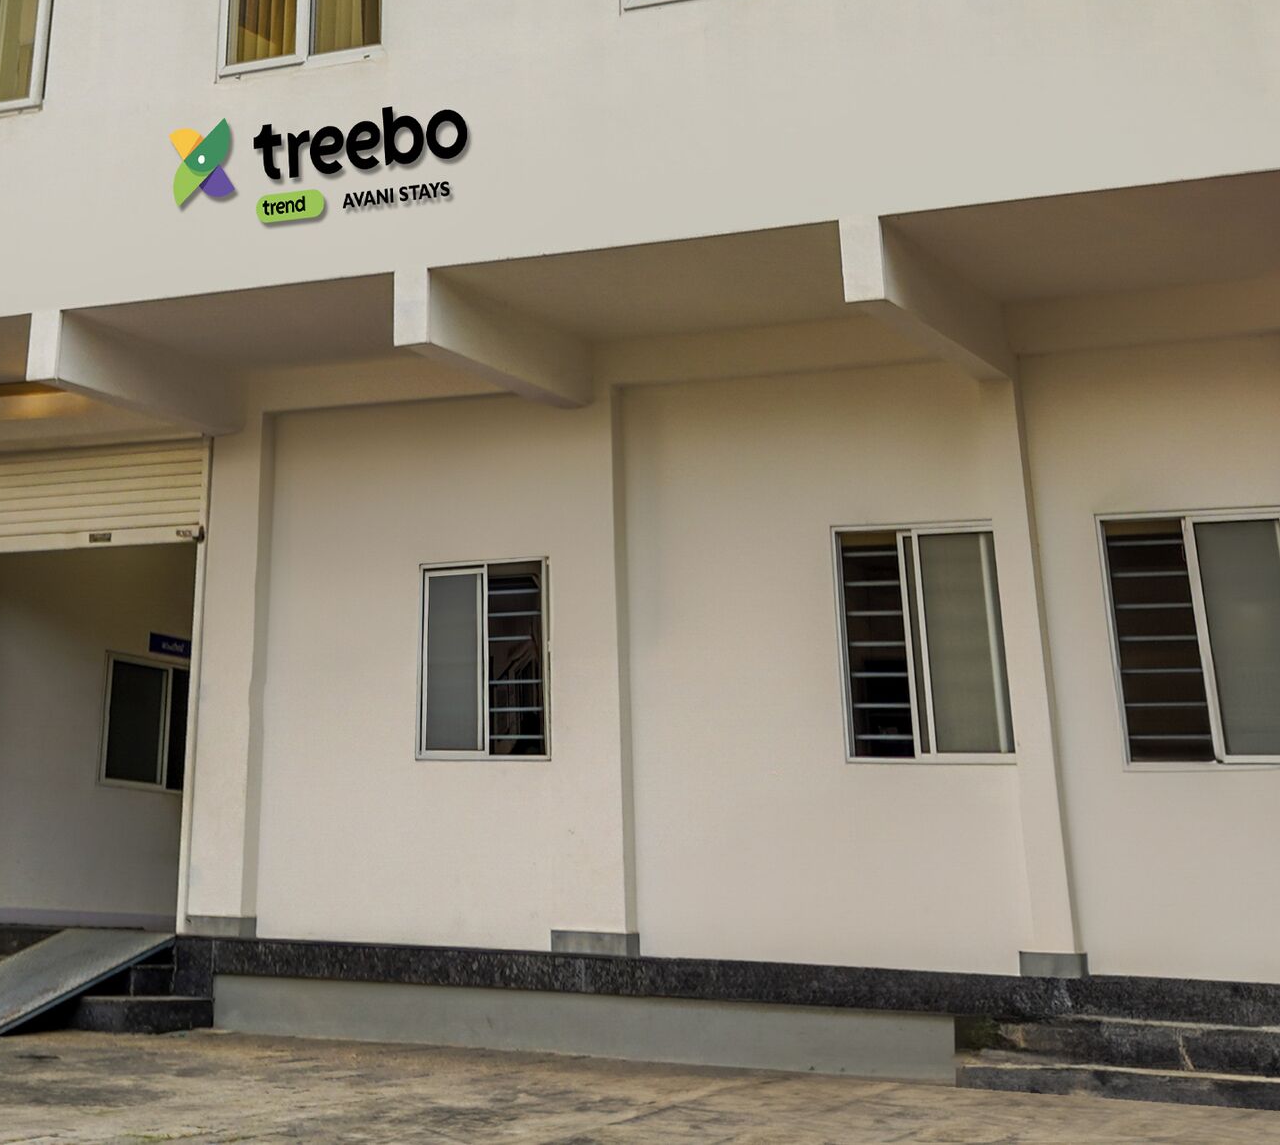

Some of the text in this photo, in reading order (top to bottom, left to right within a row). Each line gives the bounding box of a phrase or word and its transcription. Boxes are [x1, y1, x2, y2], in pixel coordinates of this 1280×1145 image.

[253, 106, 468, 180] treebo
[262, 195, 307, 216] trend
[342, 181, 451, 209] AVANI STAYS
